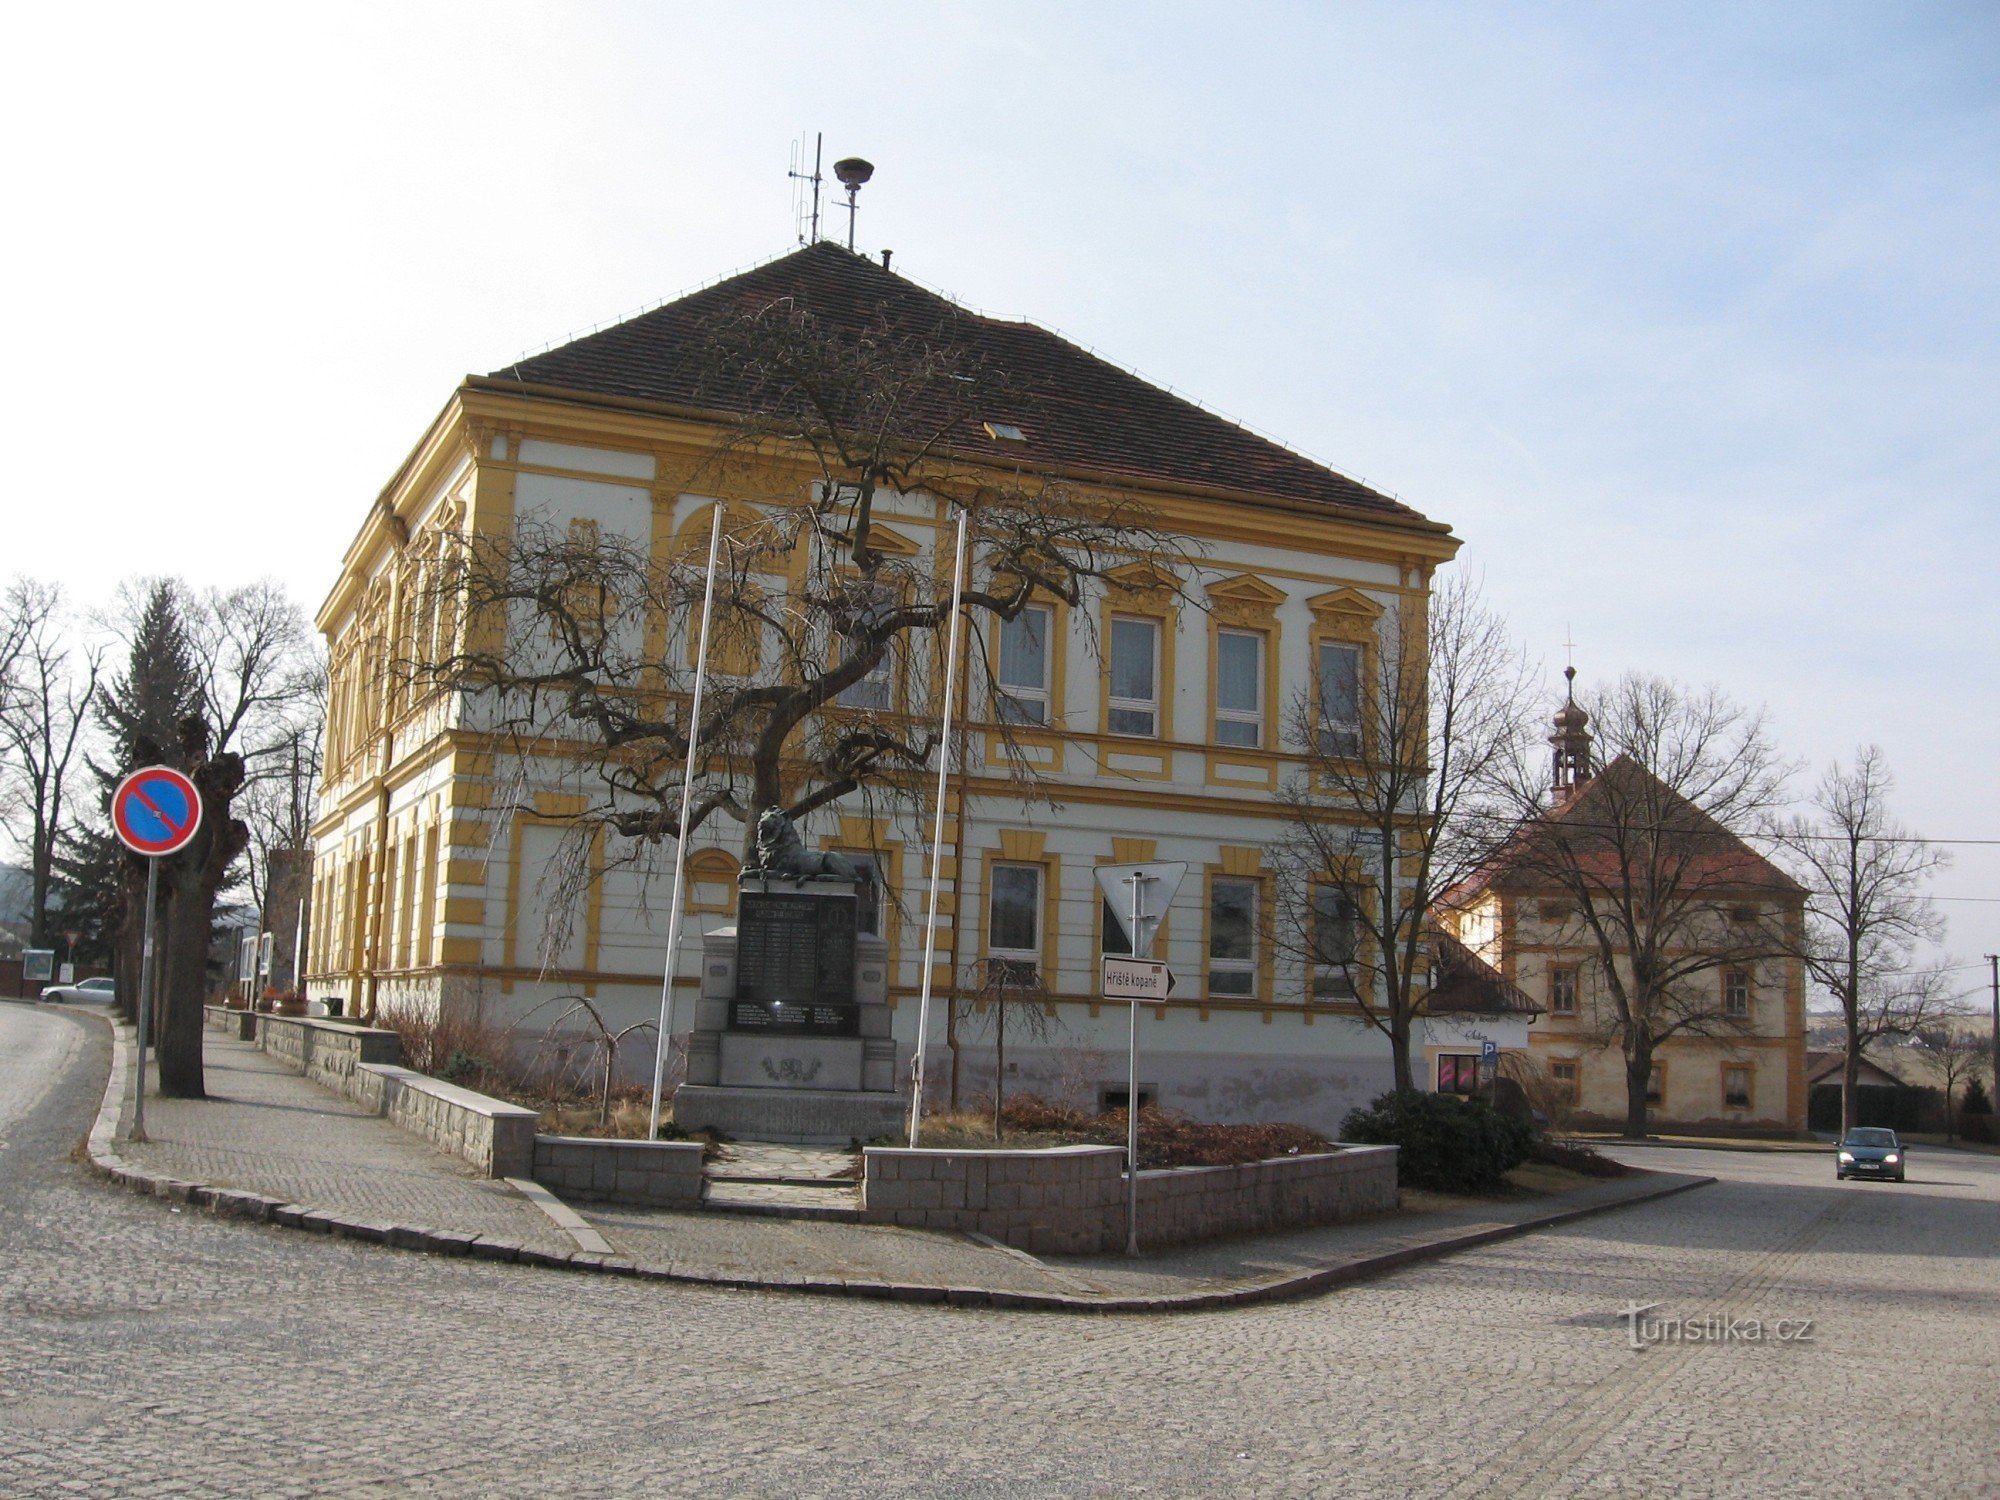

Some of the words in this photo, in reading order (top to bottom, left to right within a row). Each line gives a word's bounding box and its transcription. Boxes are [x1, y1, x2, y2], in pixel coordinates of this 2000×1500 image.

[1106, 971, 1129, 985] Hřiště
[1131, 973, 1156, 990] kopané
[1485, 1043, 1494, 1055] P
